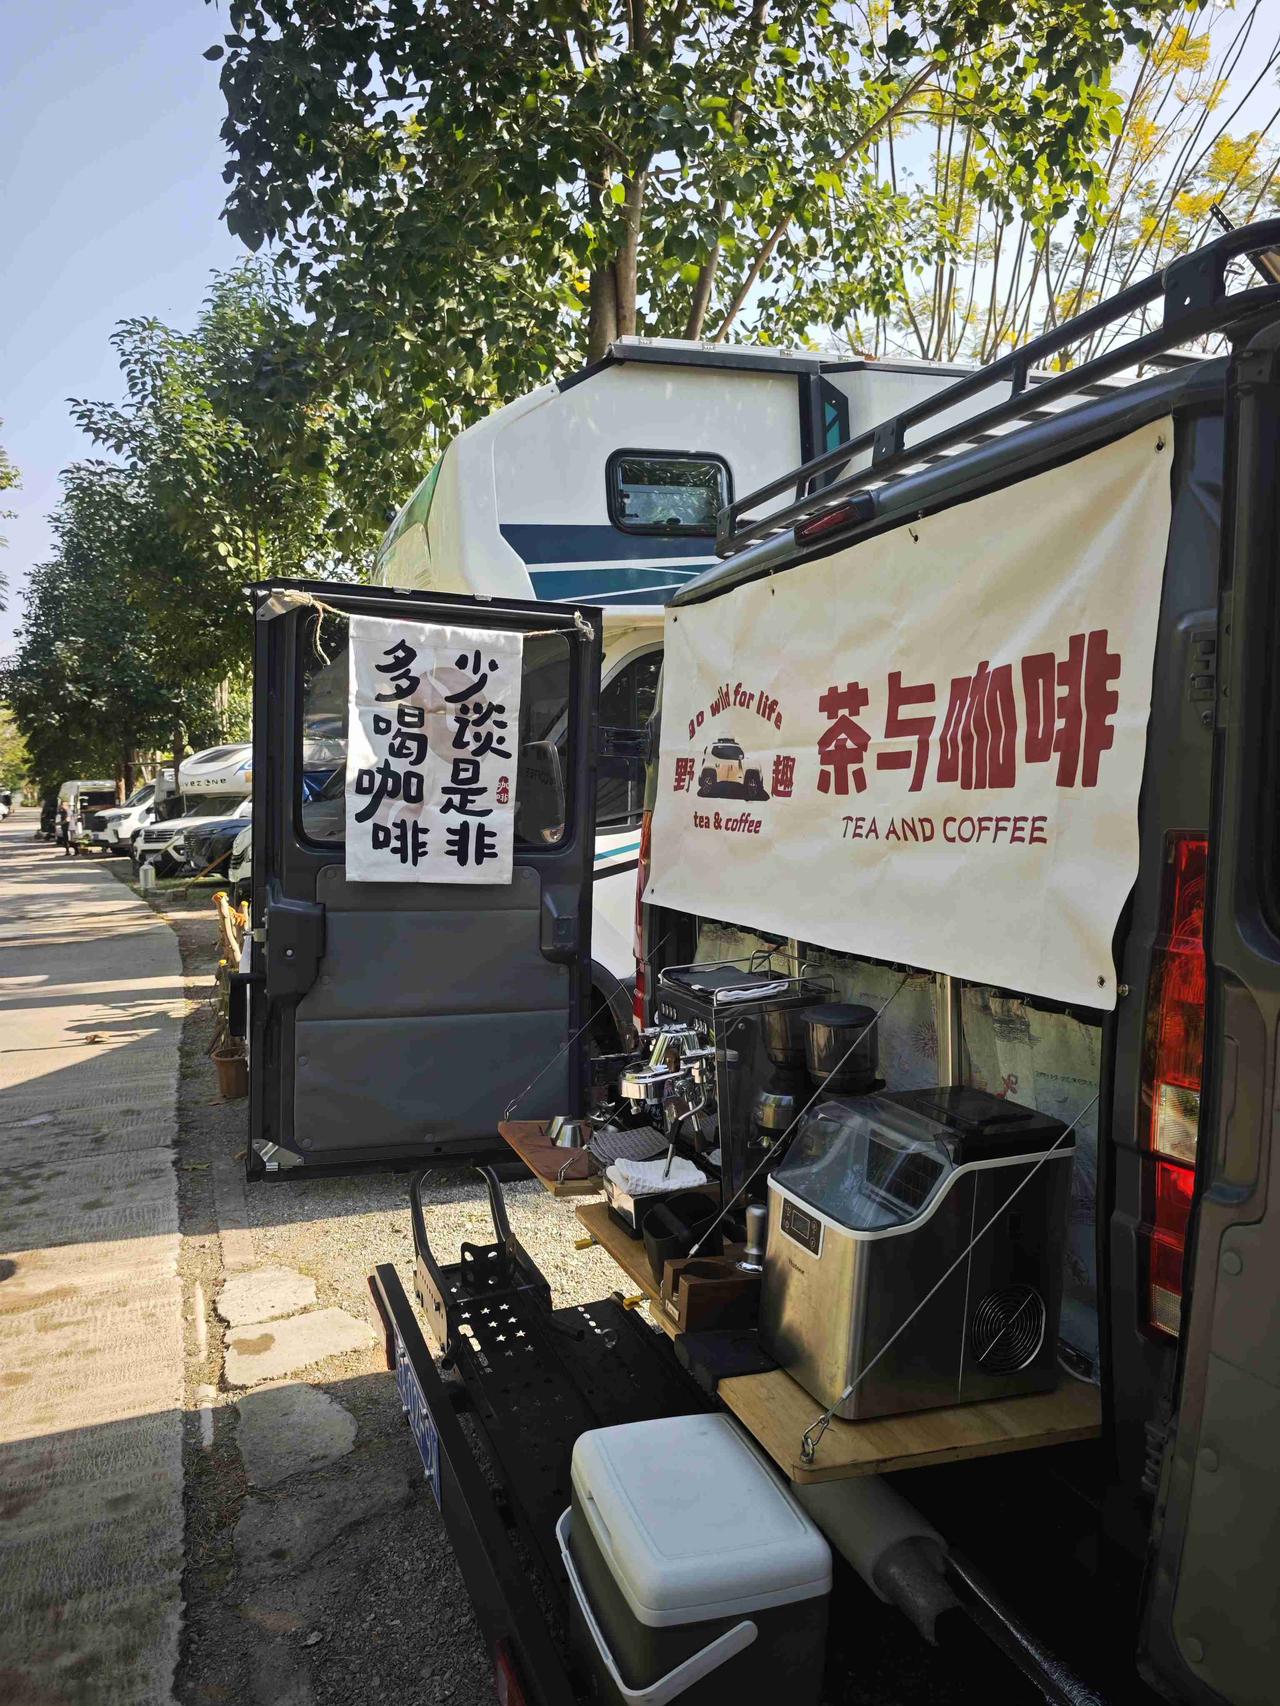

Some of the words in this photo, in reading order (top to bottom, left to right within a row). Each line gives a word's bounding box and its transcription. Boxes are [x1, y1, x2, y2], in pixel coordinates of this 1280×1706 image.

[688, 710, 705, 741] go
[710, 683, 731, 717] wild
[733, 682, 755, 710] for
[755, 690, 783, 730] life
[816, 628, 1121, 796] 茶与咖啡
[354, 638, 430, 867] 多喝咖啡
[439, 649, 513, 867] 少谈是非
[673, 756, 696, 793] 野
[693, 811, 710, 829] tea
[713, 811, 722, 831] &
[724, 812, 762, 834] coffee
[841, 815, 880, 840] TEA
[885, 815, 935, 843] AND
[942, 815, 1048, 845] COFFEE
